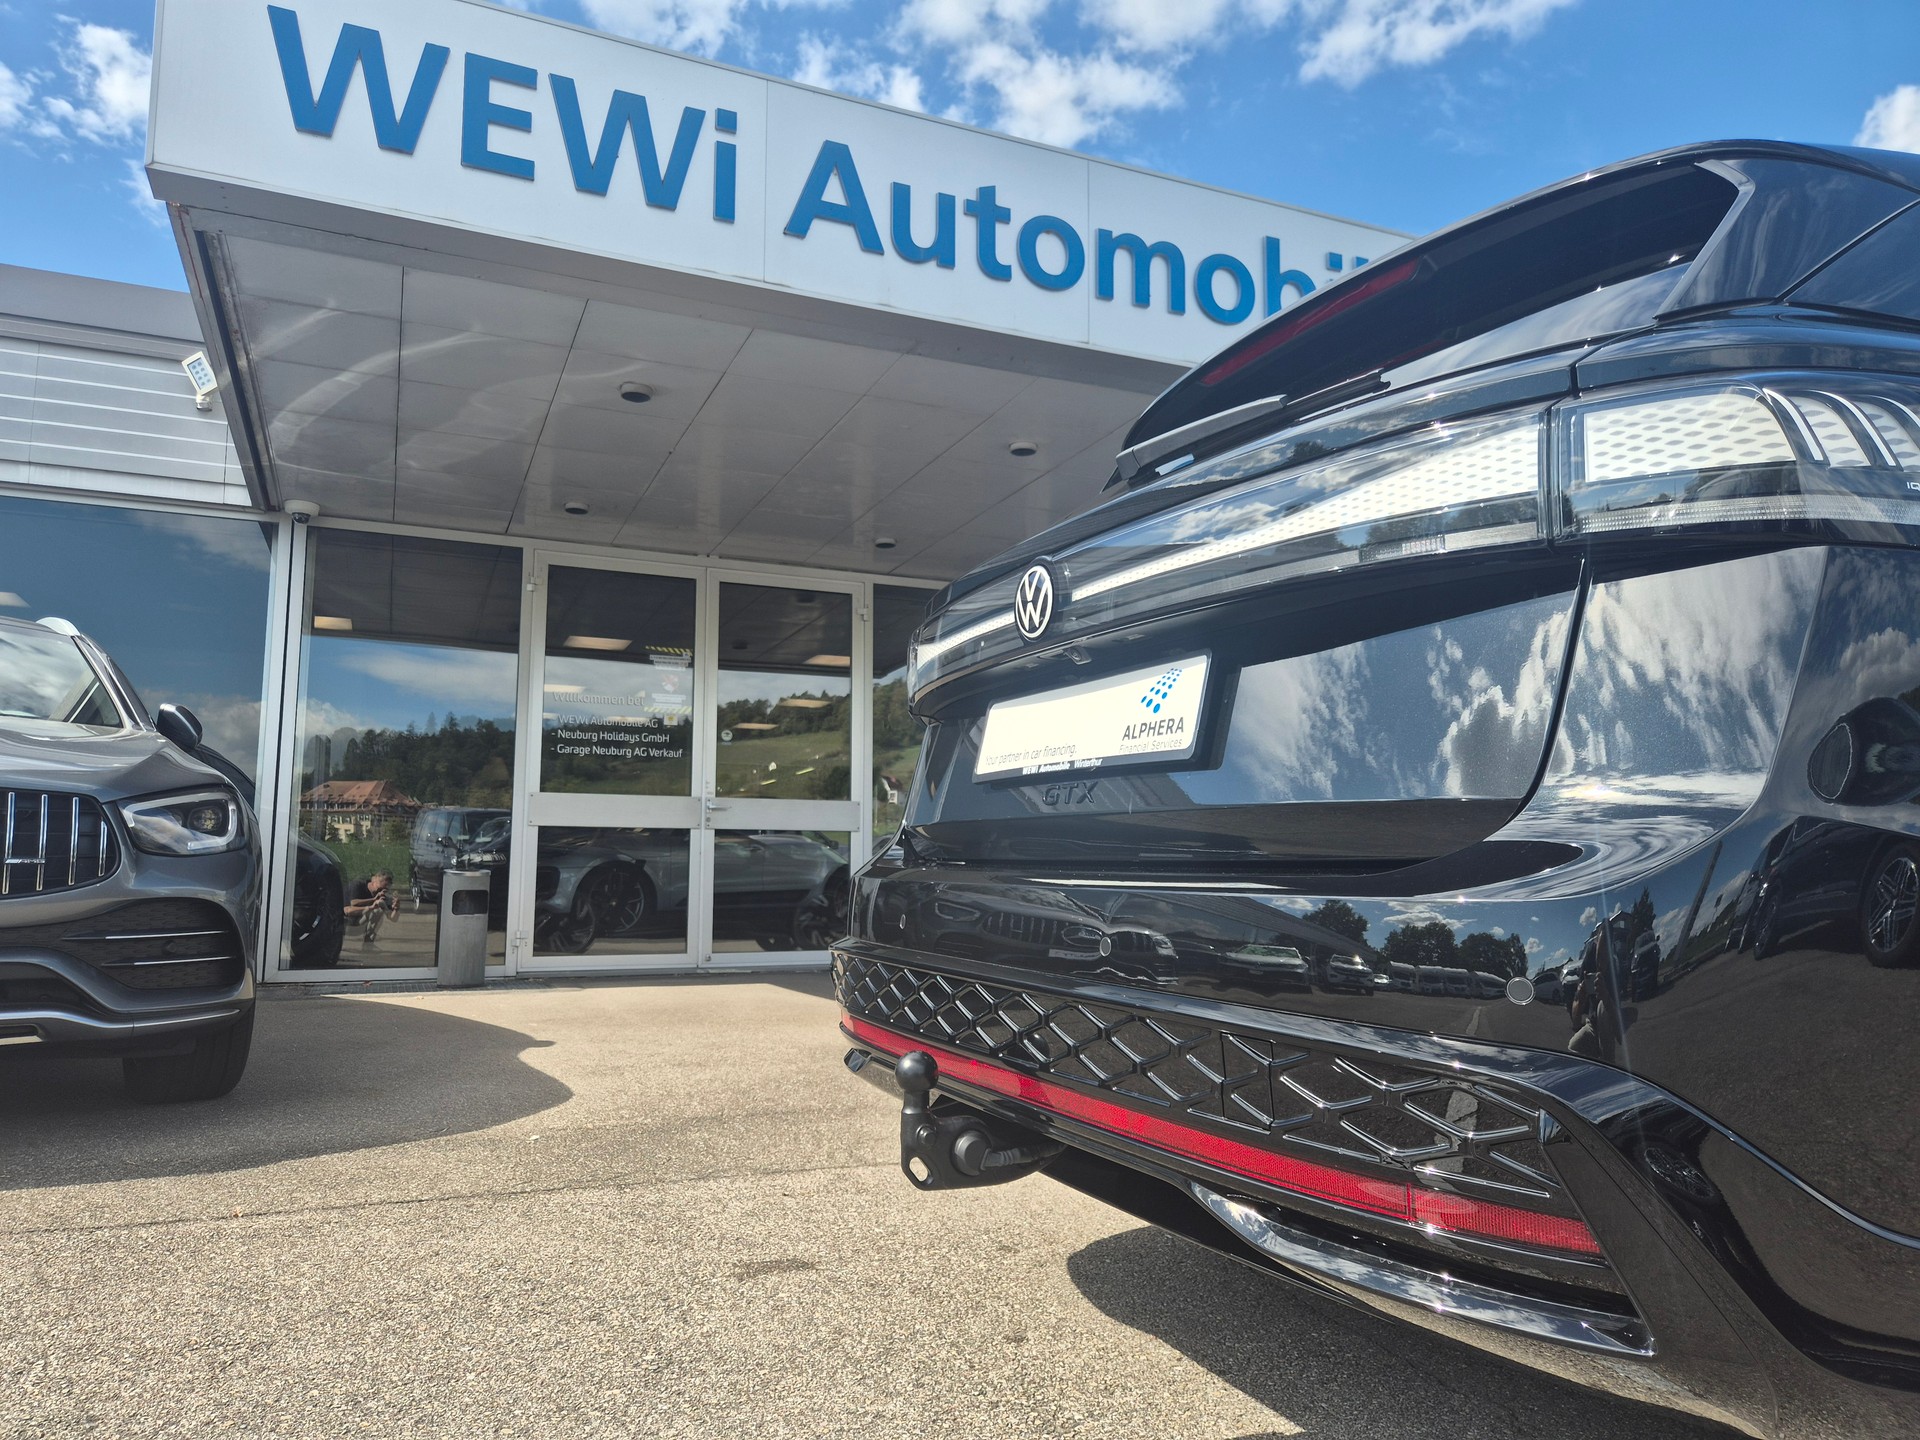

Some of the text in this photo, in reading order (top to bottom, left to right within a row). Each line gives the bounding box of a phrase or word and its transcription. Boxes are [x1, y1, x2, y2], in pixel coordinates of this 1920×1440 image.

[267, 4, 1369, 326] WEWi Automob
[553, 691, 625, 706] Willkommen
[627, 695, 645, 706] bei
[645, 719, 658, 729] AG
[1122, 716, 1184, 741] ALPHERA
[557, 729, 598, 742] Neuburg
[600, 731, 640, 744] Holidays
[641, 733, 670, 743] GmbH
[557, 744, 591, 757] Garage
[592, 745, 632, 759] Neuburg
[633, 747, 647, 757] AG
[648, 748, 683, 758] Verkauf
[1119, 738, 1183, 753] Financial Services
[998, 752, 1022, 765] partner
[1022, 749, 1030, 760] in
[1030, 748, 1042, 760] car
[1039, 761, 1070, 773] Automobile
[1074, 758, 1103, 769] Winterthur
[1042, 781, 1098, 806] GTX
